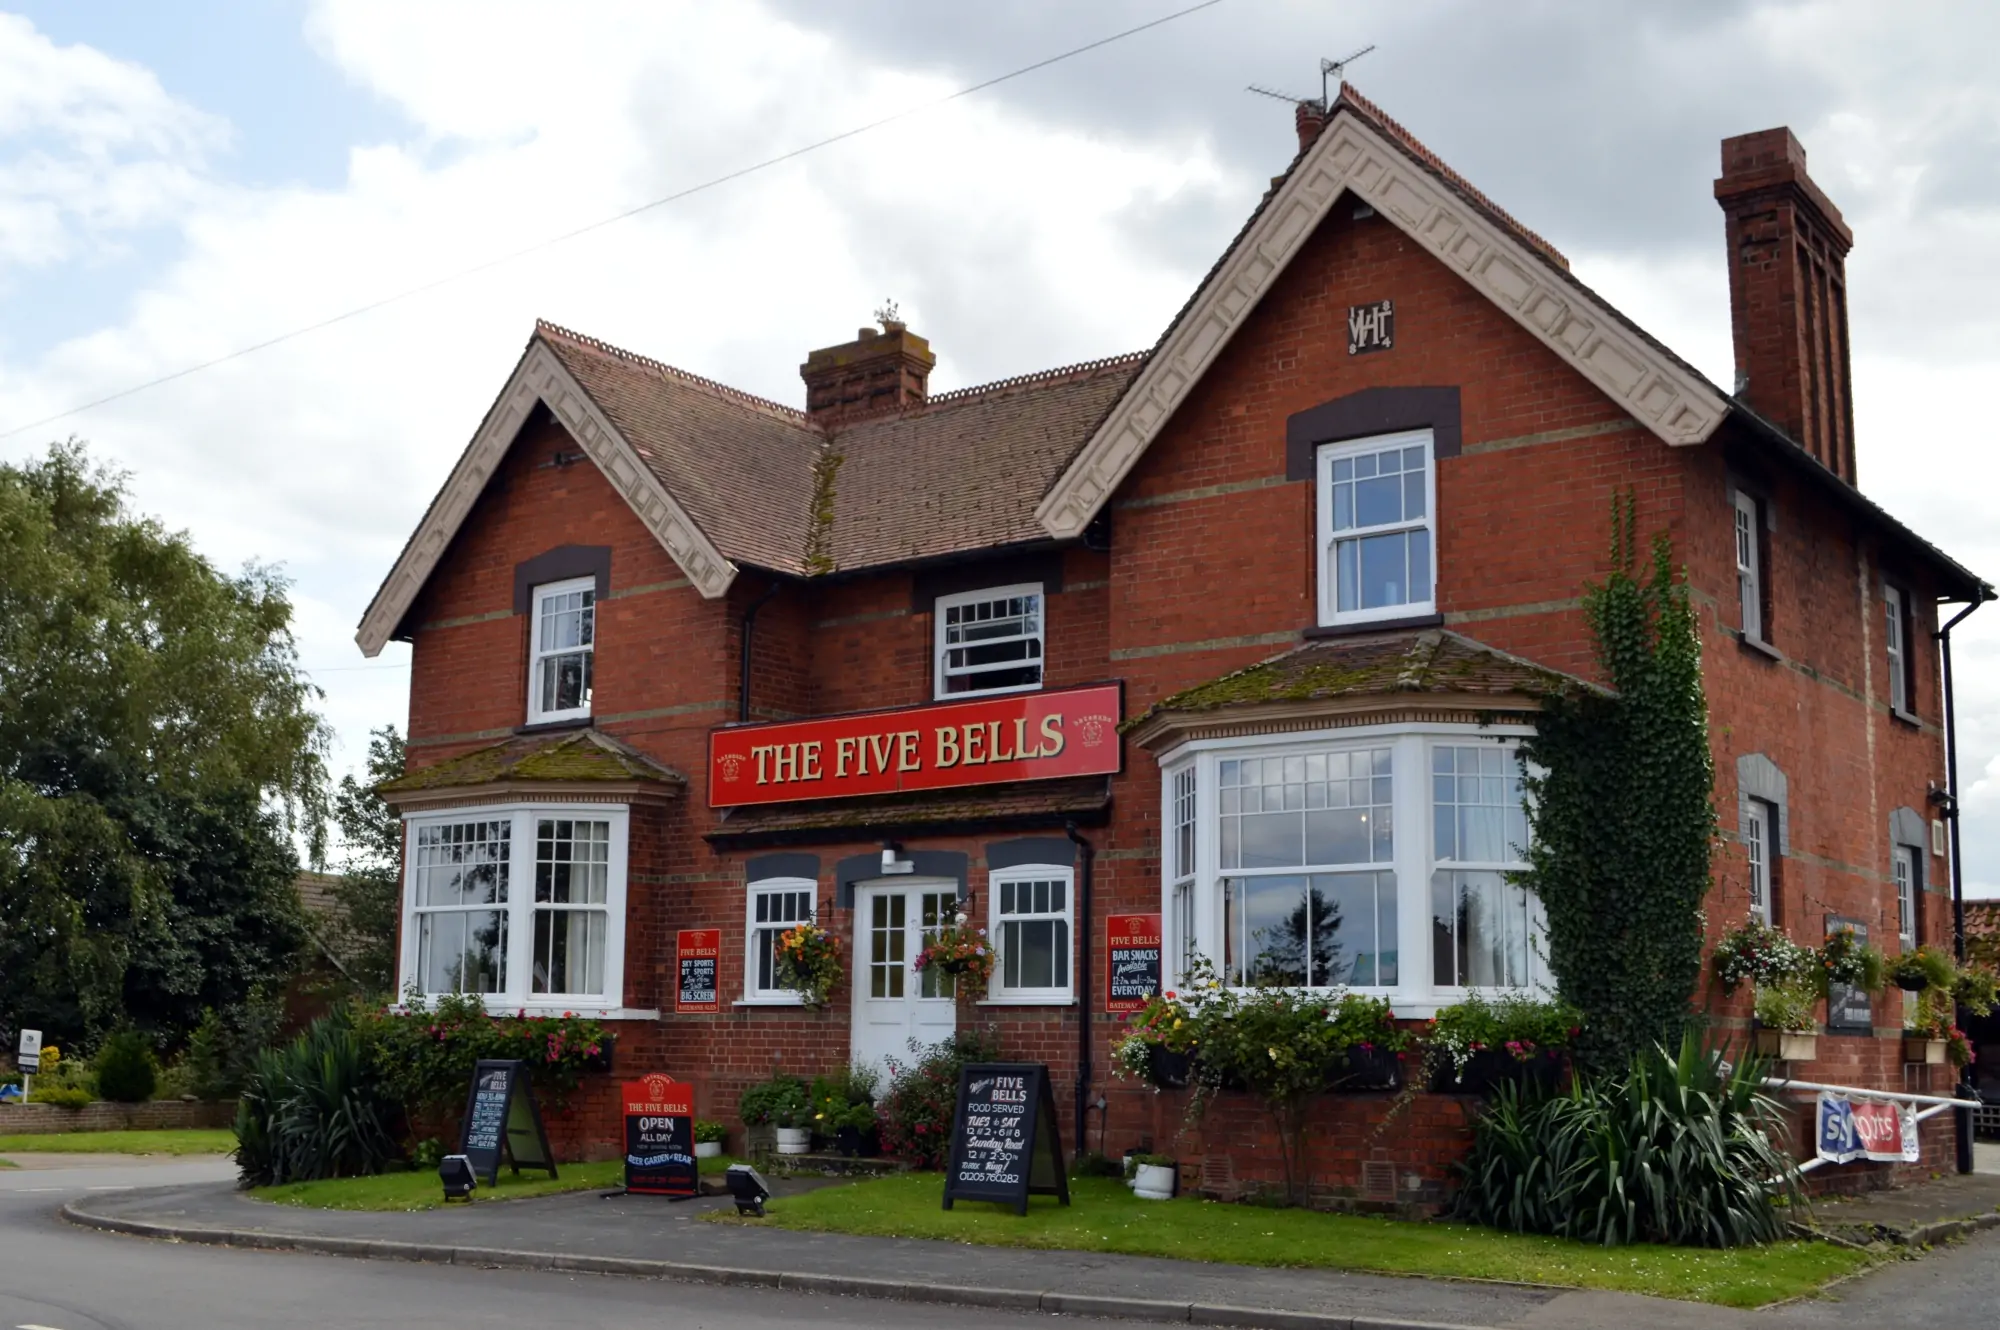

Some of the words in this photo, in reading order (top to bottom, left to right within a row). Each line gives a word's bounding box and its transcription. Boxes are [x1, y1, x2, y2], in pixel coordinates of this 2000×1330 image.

[751, 741, 823, 785] THE
[835, 730, 921, 777] FIVE
[934, 713, 1065, 768] BELLS
[1110, 936, 1130, 945] FIVE
[1132, 935, 1160, 945] BELLS
[680, 948, 695, 957] FIVE
[696, 947, 717, 956] BELLS
[1112, 950, 1130, 961] BAR
[1130, 949, 1158, 960] SNACKS
[1117, 961, 1148, 976] Available
[681, 991, 692, 1000] BIG
[693, 991, 714, 1000] SCREEN
[1112, 985, 1155, 996] EVERYDAY
[996, 1077, 1024, 1089] FIVE
[992, 1089, 1027, 1102] BELLS
[628, 1103, 643, 1112] THE
[645, 1103, 661, 1112] FIVE
[663, 1103, 687, 1113] BELLS
[968, 1103, 991, 1112] FOOD
[992, 1104, 1025, 1114] SERVED
[639, 1117, 674, 1131] OPEN
[968, 1116, 991, 1127] TUES
[1000, 1117, 1021, 1128] SAT
[640, 1133, 655, 1142] ALL
[656, 1133, 672, 1142] DAY
[967, 1127, 975, 1135] 12
[984, 1128, 991, 1136] 2
[998, 1129, 1006, 1137] 6
[1014, 1129, 1021, 1137] 8
[966, 1136, 1004, 1153] Sunday
[628, 1154, 644, 1166] BEER
[644, 1153, 669, 1166] GARDEN
[674, 1153, 692, 1164] REAR
[968, 1151, 977, 1159] 12
